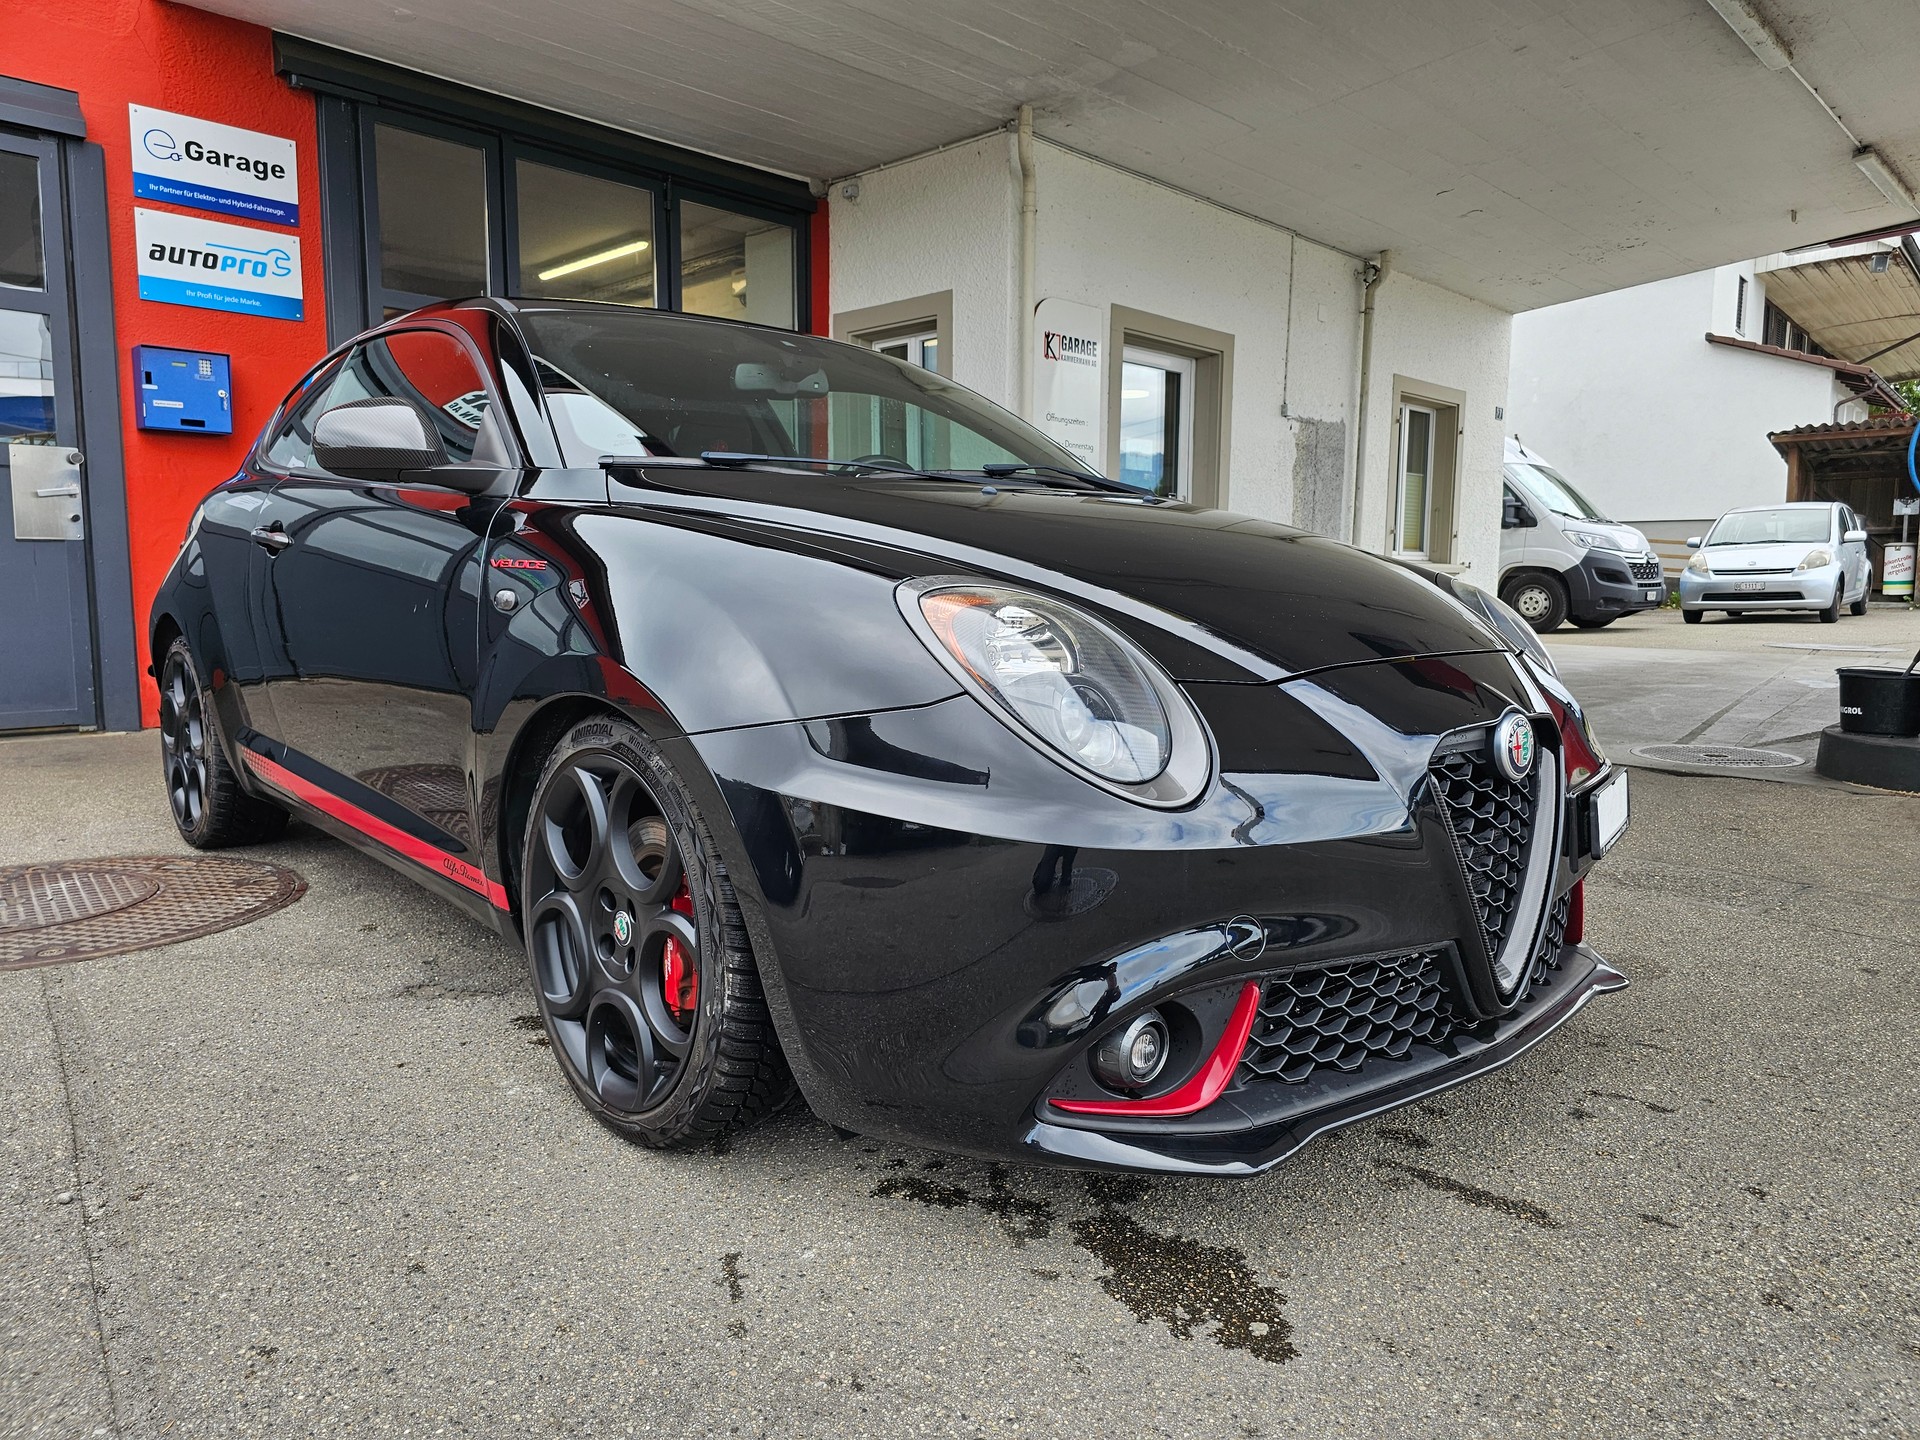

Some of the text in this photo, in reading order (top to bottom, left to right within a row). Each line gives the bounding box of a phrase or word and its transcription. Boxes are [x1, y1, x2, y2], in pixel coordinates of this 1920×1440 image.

[184, 140, 286, 181] Garage
[149, 183, 286, 217] Ihr Partner für Elektro- und Hybrid-Fahrzeuge.
[186, 290, 262, 307] Ihr Profi für jede Marke.
[1061, 334, 1098, 358] GARAGE
[1060, 354, 1097, 368] KAMMERMANN AG
[1065, 439, 1094, 454] Donnerstag
[490, 558, 548, 571] VELOCE
[1887, 566, 1911, 576] vergessen
[1890, 562, 1905, 570] nicht
[570, 722, 614, 743] UNIROYAL
